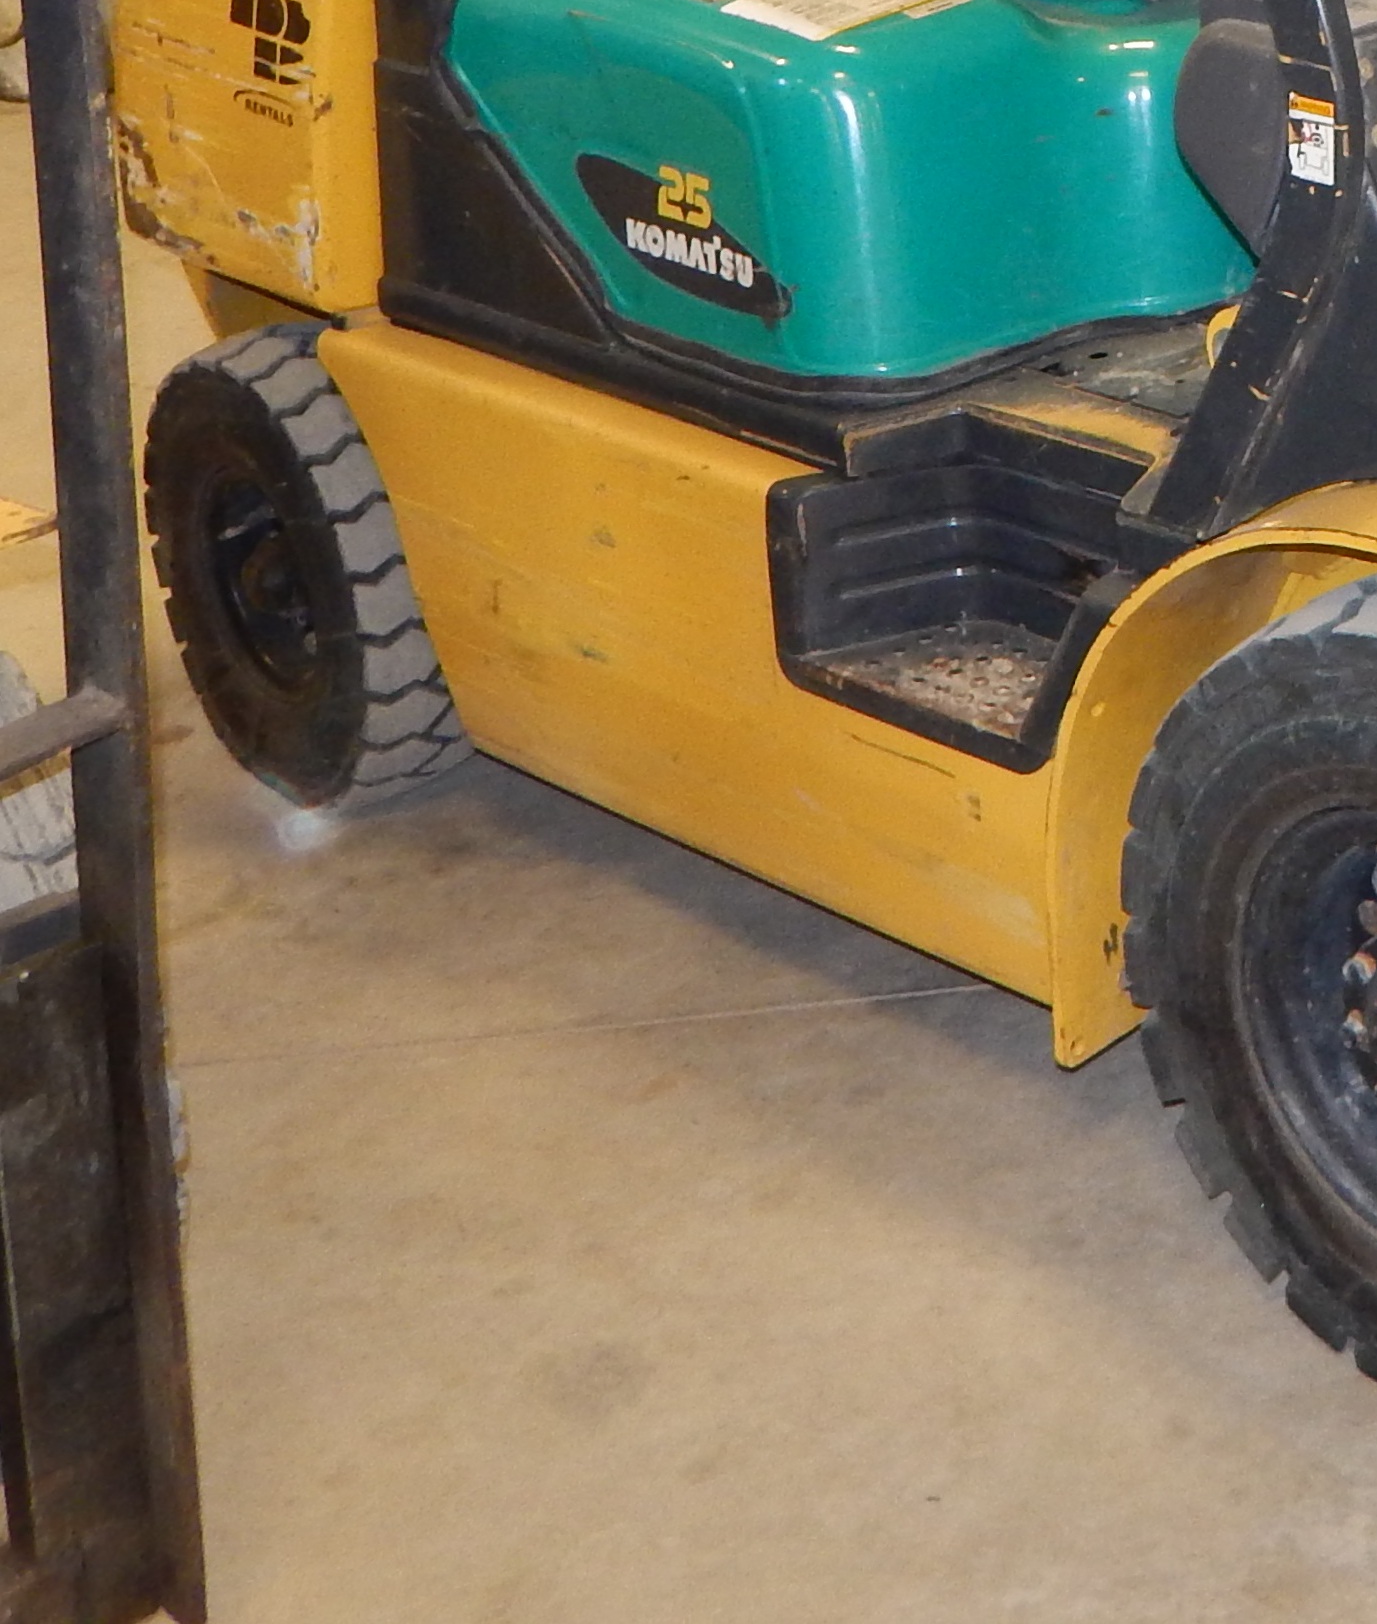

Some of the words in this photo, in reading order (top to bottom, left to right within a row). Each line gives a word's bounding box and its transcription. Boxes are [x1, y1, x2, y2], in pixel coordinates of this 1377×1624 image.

[245, 98, 294, 127] RENTALS
[657, 164, 713, 229] 25
[624, 217, 755, 289] KOMATSU
